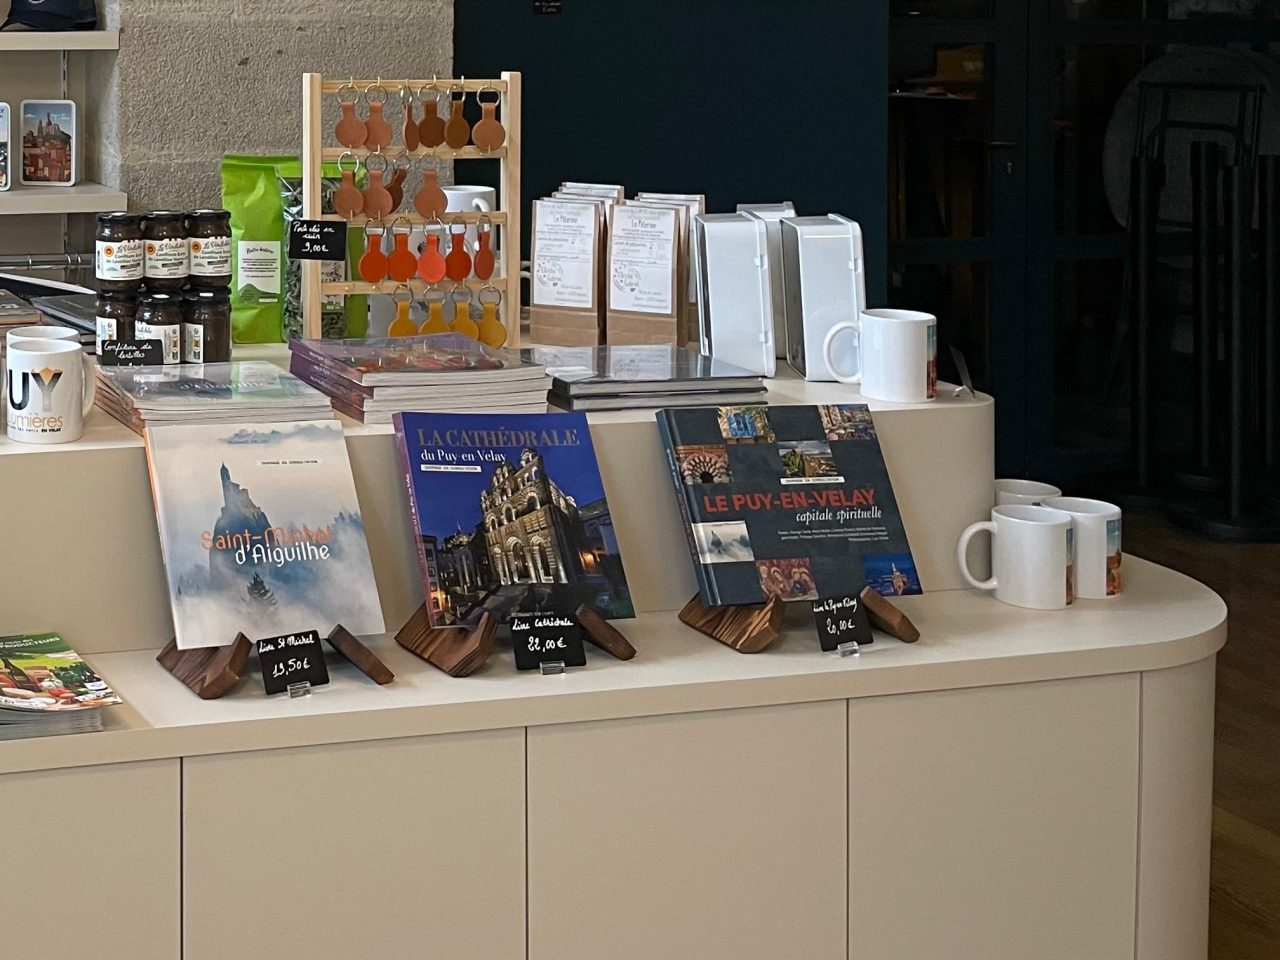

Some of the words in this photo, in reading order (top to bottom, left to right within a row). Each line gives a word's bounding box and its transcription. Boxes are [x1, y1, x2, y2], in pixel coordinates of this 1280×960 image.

[417, 429, 444, 446] LA
[446, 426, 580, 447] CATHÉDRALE
[421, 449, 435, 461] du
[703, 494, 729, 513] LE
[733, 489, 875, 510] PUY-EN-VELAY
[796, 508, 833, 525] capitale
[836, 506, 882, 523] spirituelle
[201, 524, 333, 550] Saint-Michel
[235, 541, 330, 567] d'Aiguilhe
[528, 636, 567, 652] 22,00€
